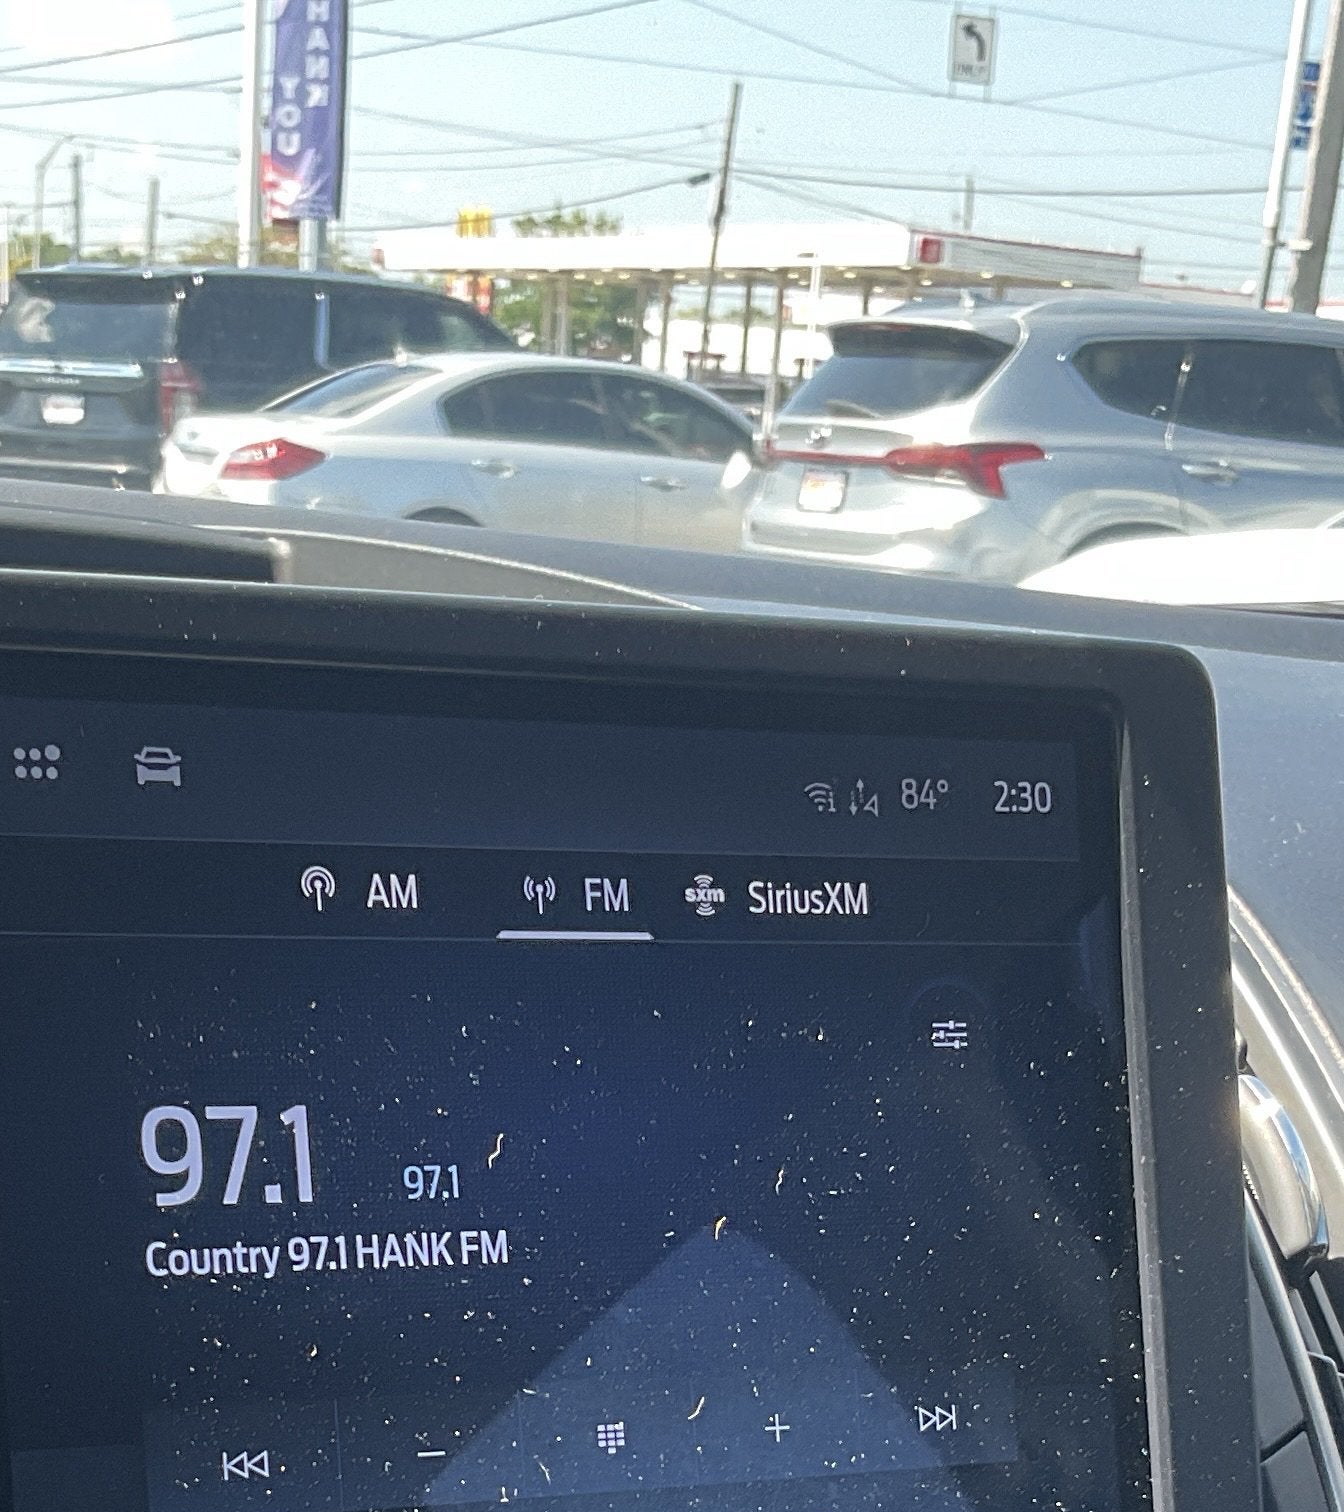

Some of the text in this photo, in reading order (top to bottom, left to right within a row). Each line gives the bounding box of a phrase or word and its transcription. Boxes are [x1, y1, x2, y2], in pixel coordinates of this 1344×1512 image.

[993, 780, 1053, 814] 2:30
[367, 873, 418, 908] AM
[584, 878, 630, 912] FM
[748, 881, 869, 916] SiriusXM
[141, 1104, 314, 1206] 97.1
[403, 1165, 461, 1200] 97.1
[145, 1229, 509, 1280] Country 97.1 HANK FM
